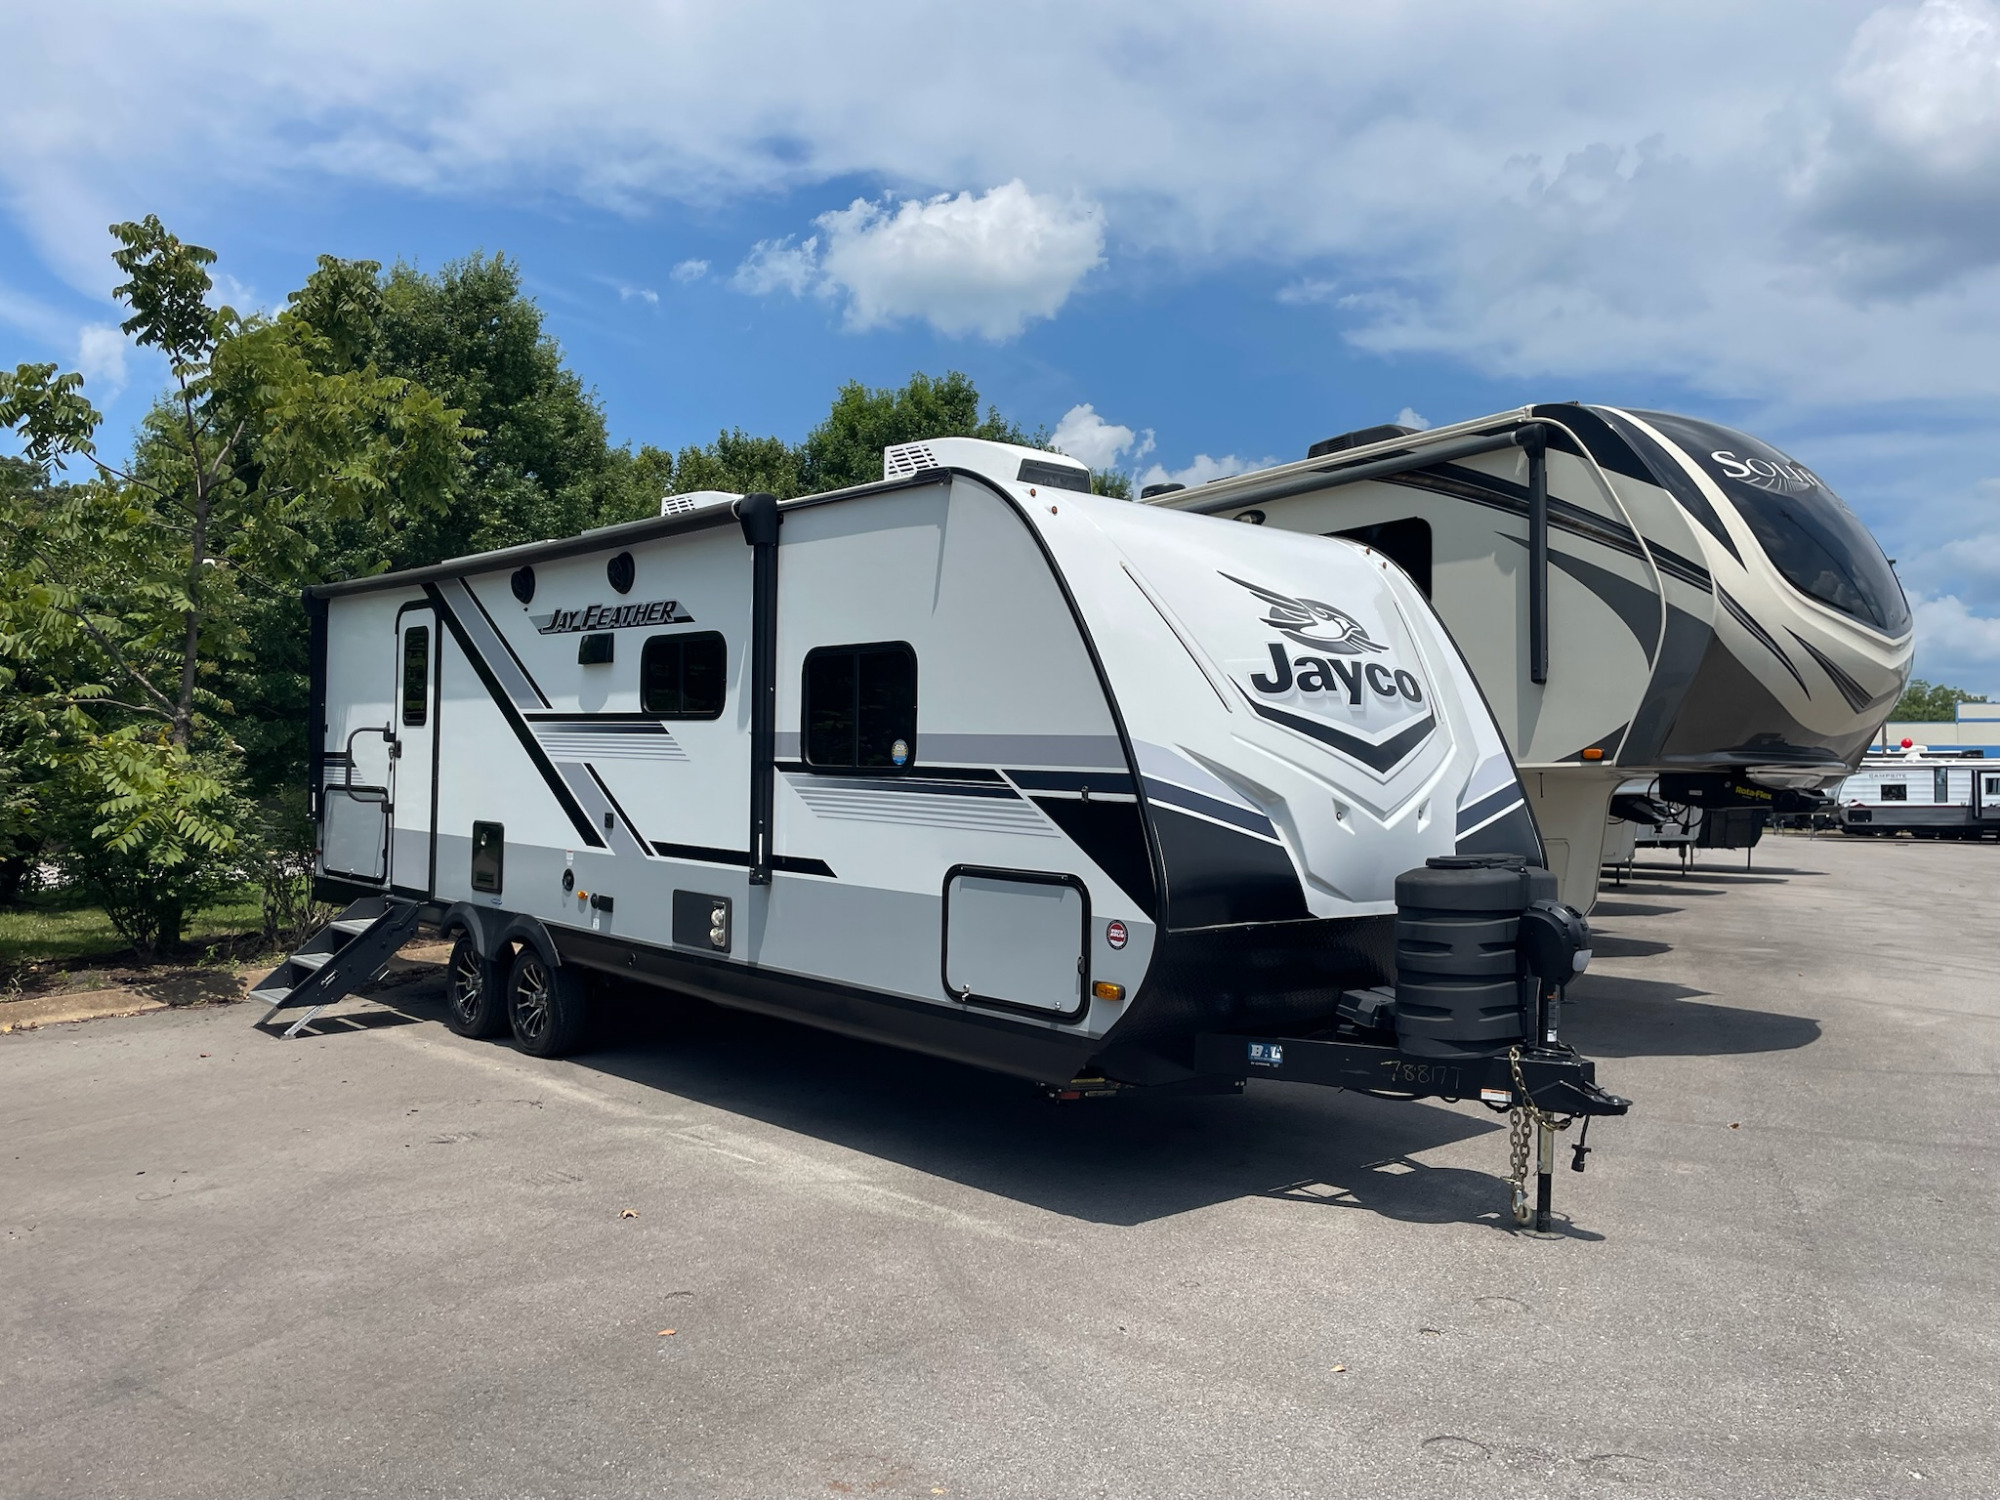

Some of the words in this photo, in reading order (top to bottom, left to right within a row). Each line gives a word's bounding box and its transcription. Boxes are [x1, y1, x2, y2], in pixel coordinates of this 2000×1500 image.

[541, 607, 578, 634] JAY
[580, 600, 677, 631] FEATHER
[1249, 641, 1423, 706] Jayco
